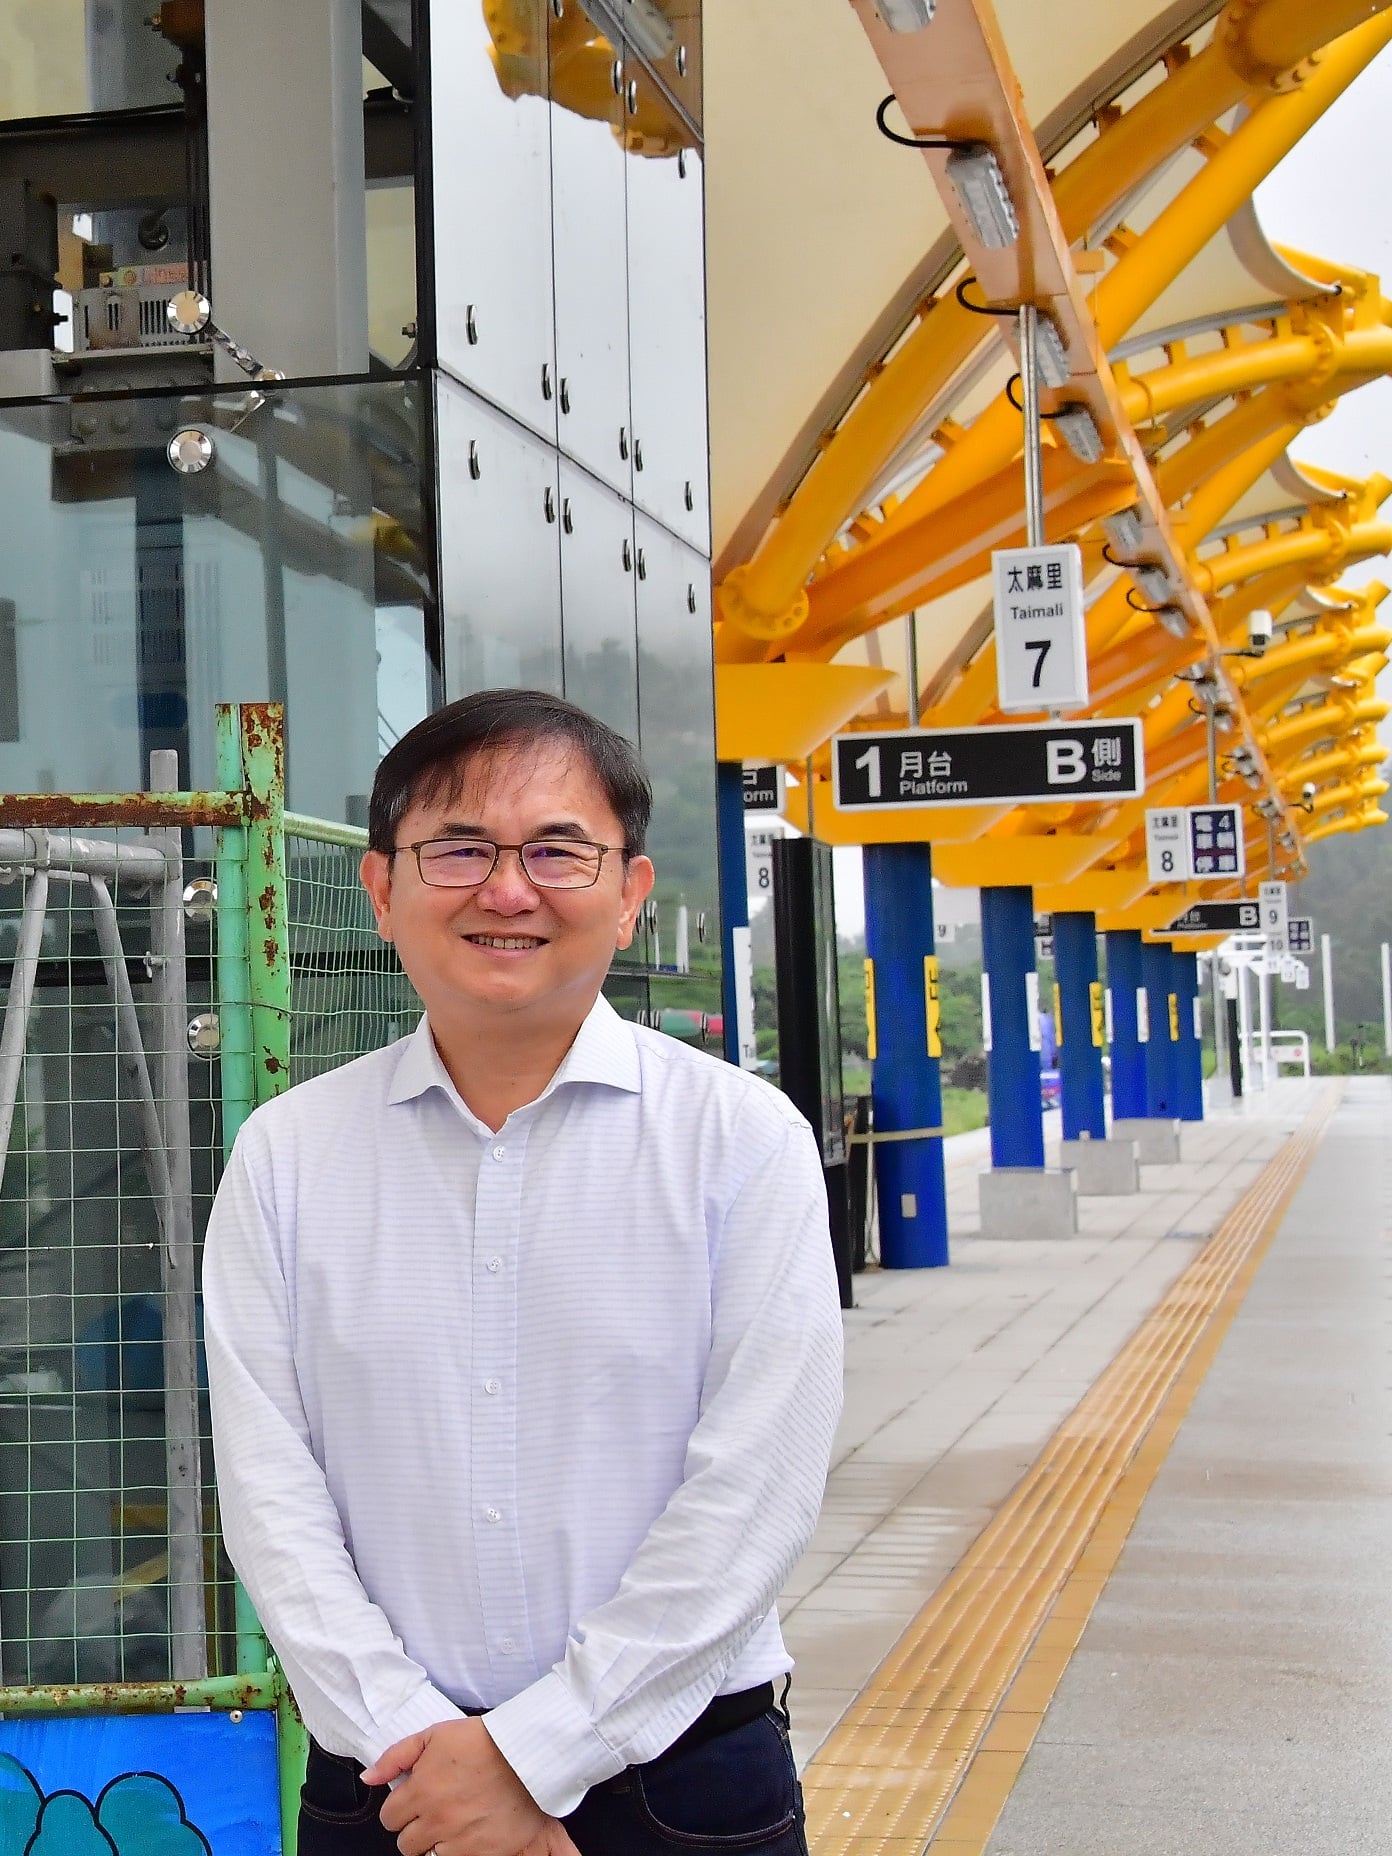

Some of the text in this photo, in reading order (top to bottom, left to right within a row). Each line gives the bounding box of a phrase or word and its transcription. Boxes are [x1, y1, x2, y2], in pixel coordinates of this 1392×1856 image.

[1008, 563, 1063, 594] 太麻里
[1010, 603, 1064, 620] Taimali
[1025, 640, 1051, 687] 7
[855, 737, 1121, 797] 1 月台 B 側
[899, 768, 1122, 795] Platform Side
[1162, 850, 1174, 872] 8
[759, 867, 770, 888] 8
[1239, 906, 1258, 926] B
